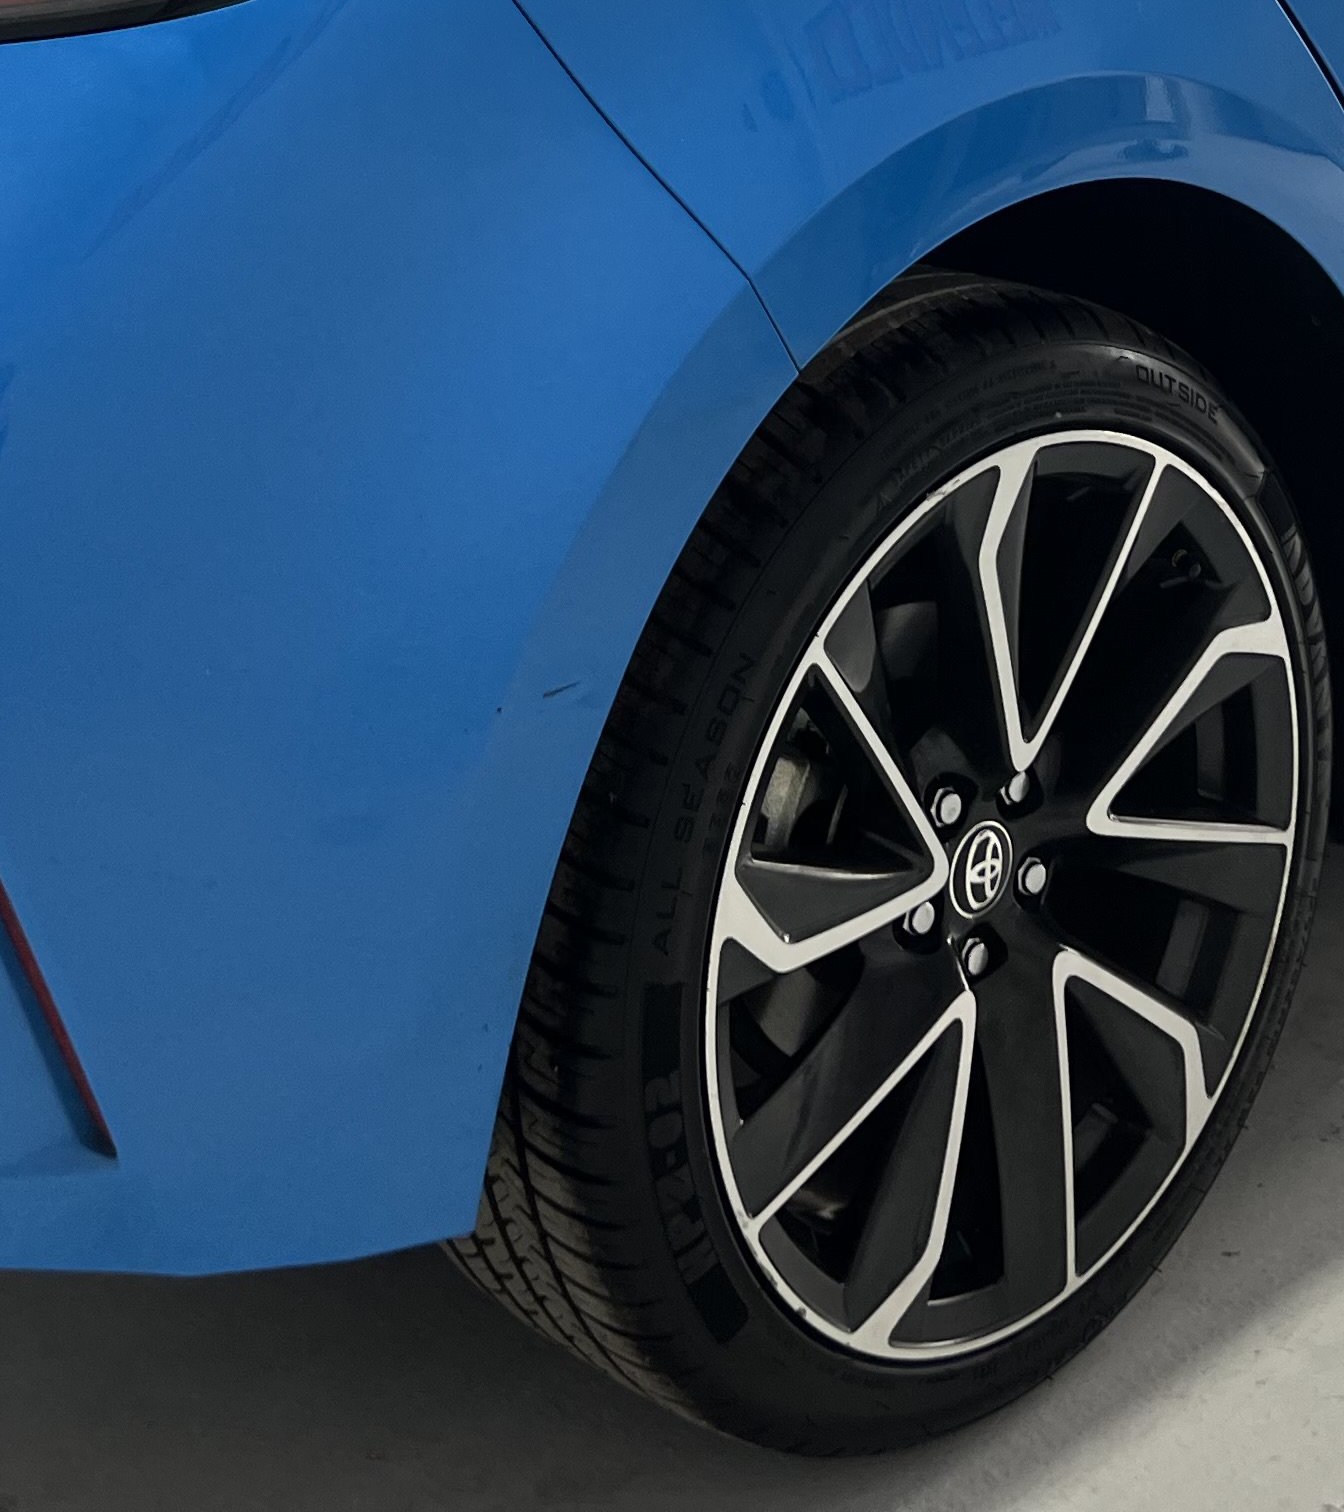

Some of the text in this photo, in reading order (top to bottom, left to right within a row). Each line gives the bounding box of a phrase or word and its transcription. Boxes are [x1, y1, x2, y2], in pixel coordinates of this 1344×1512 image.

[1135, 364, 1219, 426] OUTSIDE
[652, 867, 683, 956] ALL
[673, 653, 755, 844] SEASON
